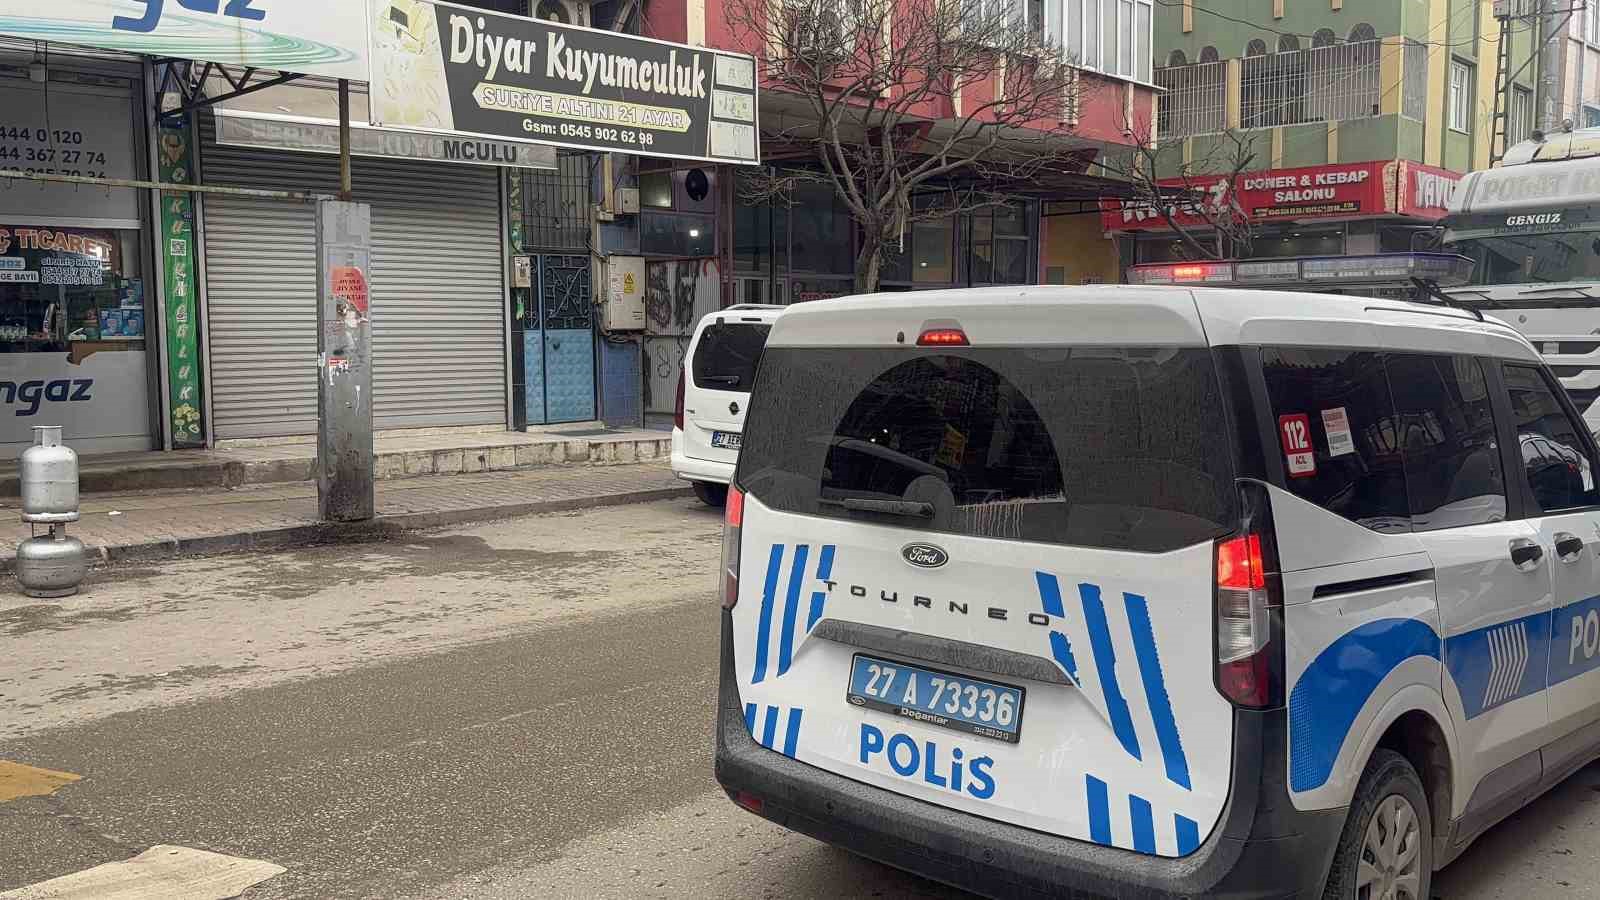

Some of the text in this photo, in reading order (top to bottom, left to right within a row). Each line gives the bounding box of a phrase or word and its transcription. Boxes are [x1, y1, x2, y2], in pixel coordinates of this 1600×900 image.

[449, 13, 706, 99] Diyar Kuyumculuk
[618, 106, 638, 124] 21
[640, 109, 685, 129] AYAR
[36, 128, 47, 142] 0
[53, 130, 83, 145] 120
[522, 118, 654, 145] Gsm: 0545 902 62 98
[61, 150, 81, 164] 27
[86, 151, 106, 165] 74
[1300, 174, 1313, 187] &
[1315, 170, 1369, 185] KEBAP
[1274, 187, 1336, 203] SALONU
[1284, 420, 1309, 450] 112
[909, 546, 938, 564] Ford
[824, 579, 1051, 627] TOURNEO
[1569, 609, 1600, 664] PO
[865, 664, 1015, 727] 27 A 73336
